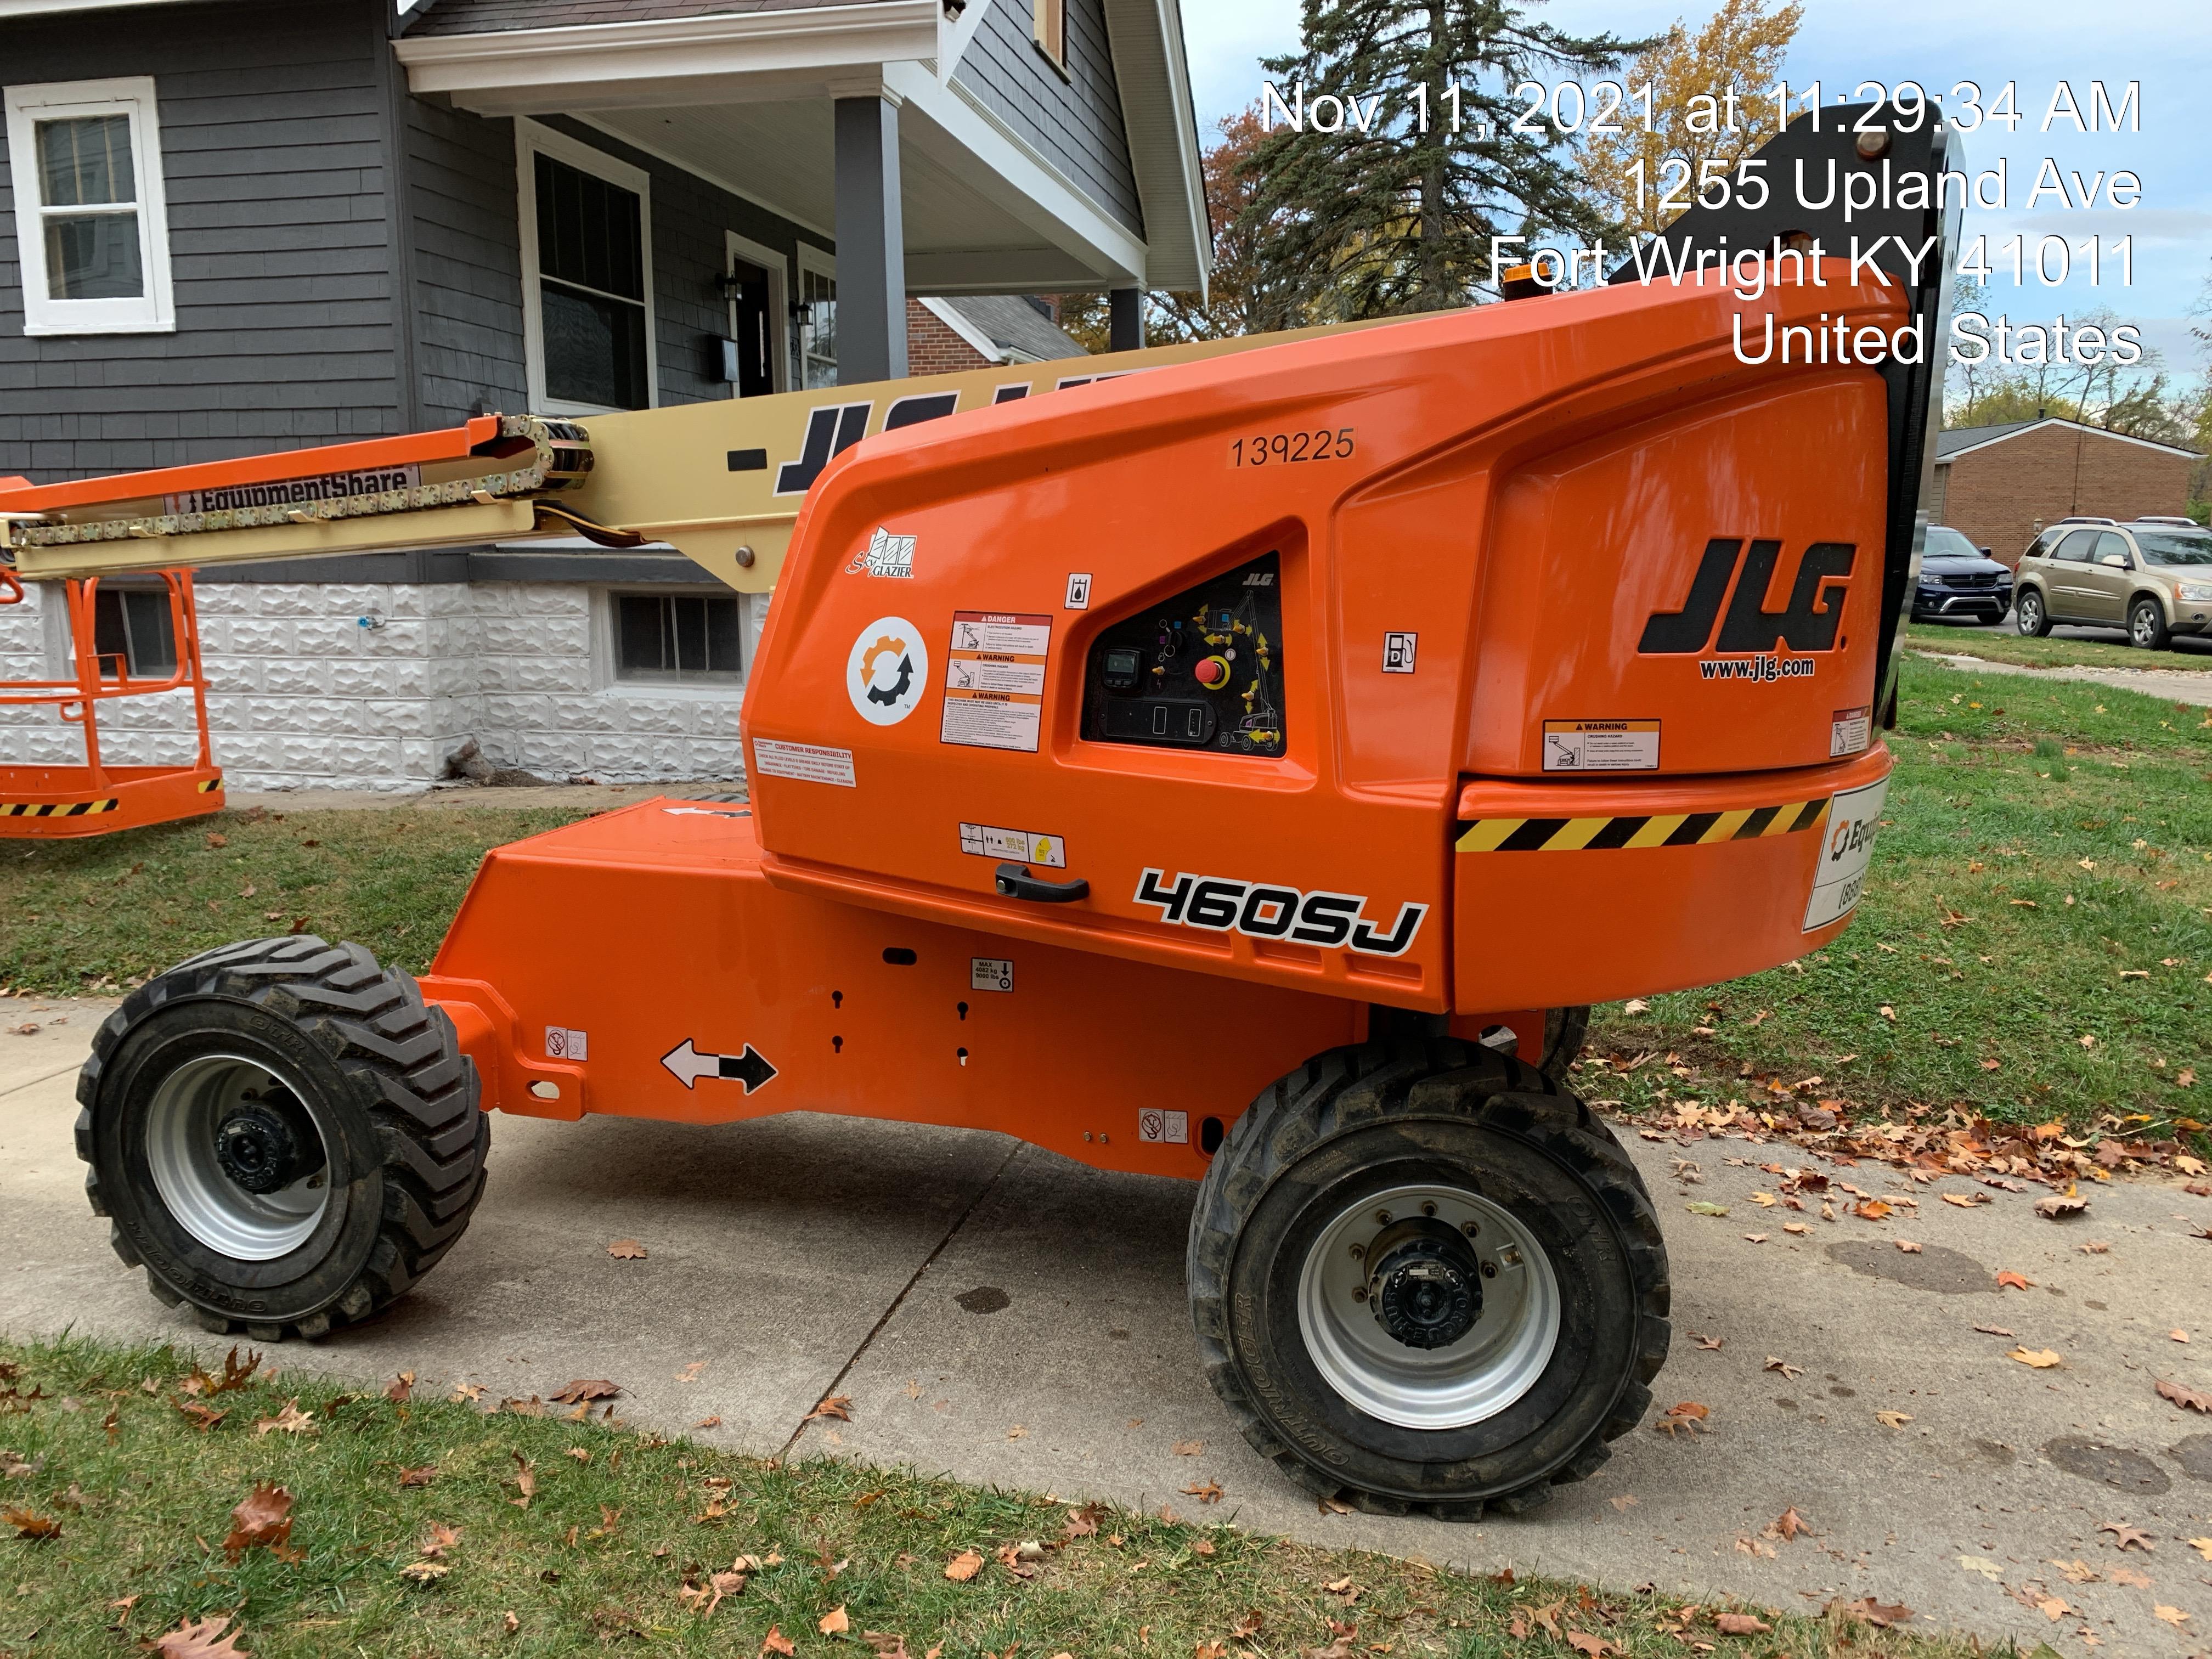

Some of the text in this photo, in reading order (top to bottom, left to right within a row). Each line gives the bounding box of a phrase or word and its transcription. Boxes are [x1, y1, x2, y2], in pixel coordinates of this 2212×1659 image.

[1232, 428, 1354, 467] 139225
[873, 566, 912, 578] GLAZIER
[1242, 573, 1274, 586] JLG
[1638, 539, 1858, 653] JLG
[1700, 656, 1814, 682] www.jlg.com
[979, 692, 1010, 701] WARNING
[775, 743, 804, 753] CUSTOMER
[805, 748, 851, 759] RESPONSIBILITY
[1136, 869, 1426, 956] 460SJ
[1234, 1293, 1350, 1465] OUTRIGGER
